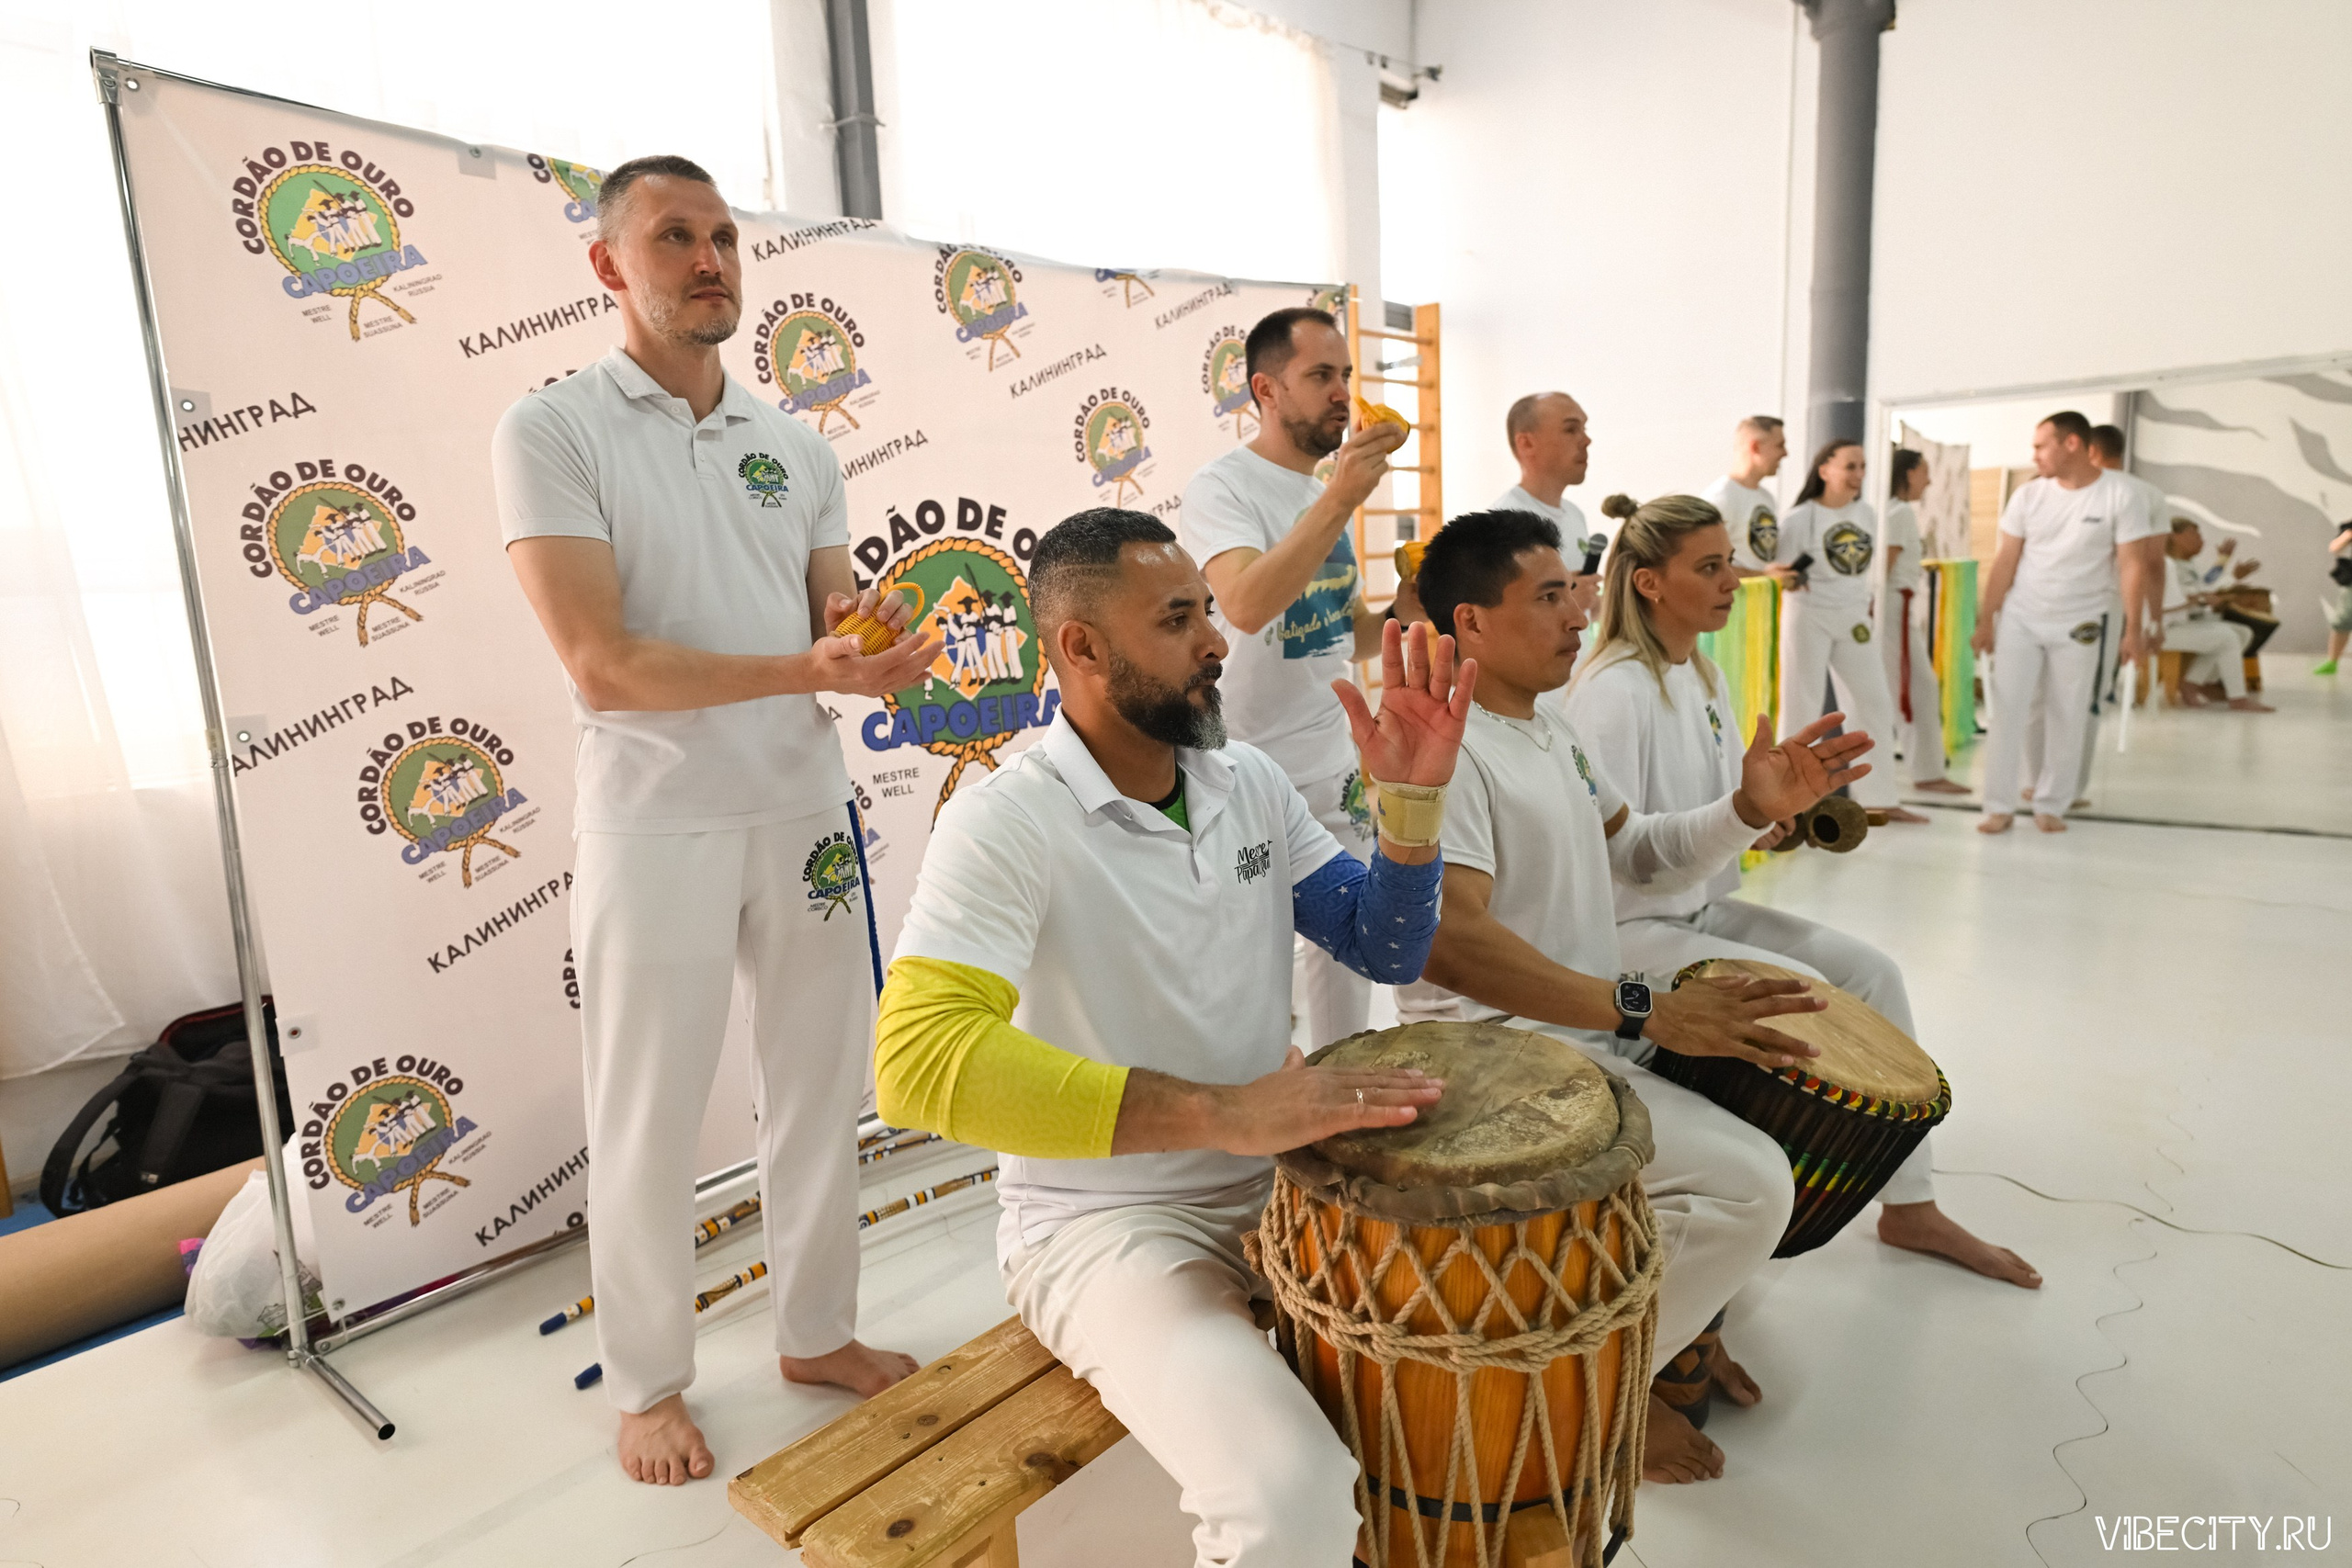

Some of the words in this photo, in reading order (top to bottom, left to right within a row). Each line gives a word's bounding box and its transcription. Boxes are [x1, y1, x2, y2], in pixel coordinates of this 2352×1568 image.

[232, 146, 287, 254] CORDÃO
[289, 141, 332, 162] DE
[340, 150, 414, 218] OURO
[282, 244, 428, 299] CAPOEIRA
[301, 304, 332, 318] MESTRE
[311, 314, 332, 323] WELL
[363, 315, 394, 329] MESTRE
[458, 292, 618, 358] КАЛИНИНГРА
[754, 299, 787, 384] CORDÃO
[790, 292, 815, 309] DE
[820, 298, 865, 348] OURO
[778, 368, 872, 415] CAPOEIRA
[1009, 343, 1107, 399] КАЛИНИНГРАД
[177, 391, 317, 452] НИНГРАД
[1074, 394, 1098, 462] CORDÃO
[1100, 387, 1117, 400] DE
[1122, 390, 1150, 429] OURO
[738, 453, 756, 478] CORDÃO
[759, 452, 770, 460] DE
[772, 458, 789, 479] OURO
[240, 470, 292, 579] CORDÃO
[295, 459, 336, 481] DE
[345, 464, 416, 521] OURO
[956, 497, 1007, 540] DE
[289, 546, 432, 615] CAPOEIRA
[309, 615, 339, 631] MESTRE
[318, 625, 340, 637] WELL
[371, 616, 401, 632] MESTRE
[232, 676, 413, 777] АЛИНИНГРАД
[862, 689, 1062, 751] CAPOEIRA
[357, 733, 404, 835] CORDÃO
[406, 716, 443, 739] DE
[450, 717, 514, 766] OURO
[873, 767, 920, 785] MESTRE
[882, 784, 914, 798] WELL
[401, 787, 528, 865] CAPOEIRA
[419, 861, 447, 880] MESTRE
[427, 871, 447, 884] WELL
[474, 855, 502, 874] MESTRE
[802, 836, 831, 882] CORDÃO
[833, 831, 844, 842] DE
[808, 876, 861, 899] CAPOEIRA
[427, 871, 573, 974] КАЛИНИНГРА
[300, 1082, 348, 1190] CORDÃO
[350, 1057, 389, 1086] DE
[395, 1055, 464, 1096] OURO
[345, 1115, 479, 1213] CAPOEIRA
[363, 1203, 393, 1226] MESTRE
[372, 1213, 393, 1229] WELL
[423, 1188, 450, 1210] MESTRE
[475, 1146, 589, 1247] КАЛИНИНГ
